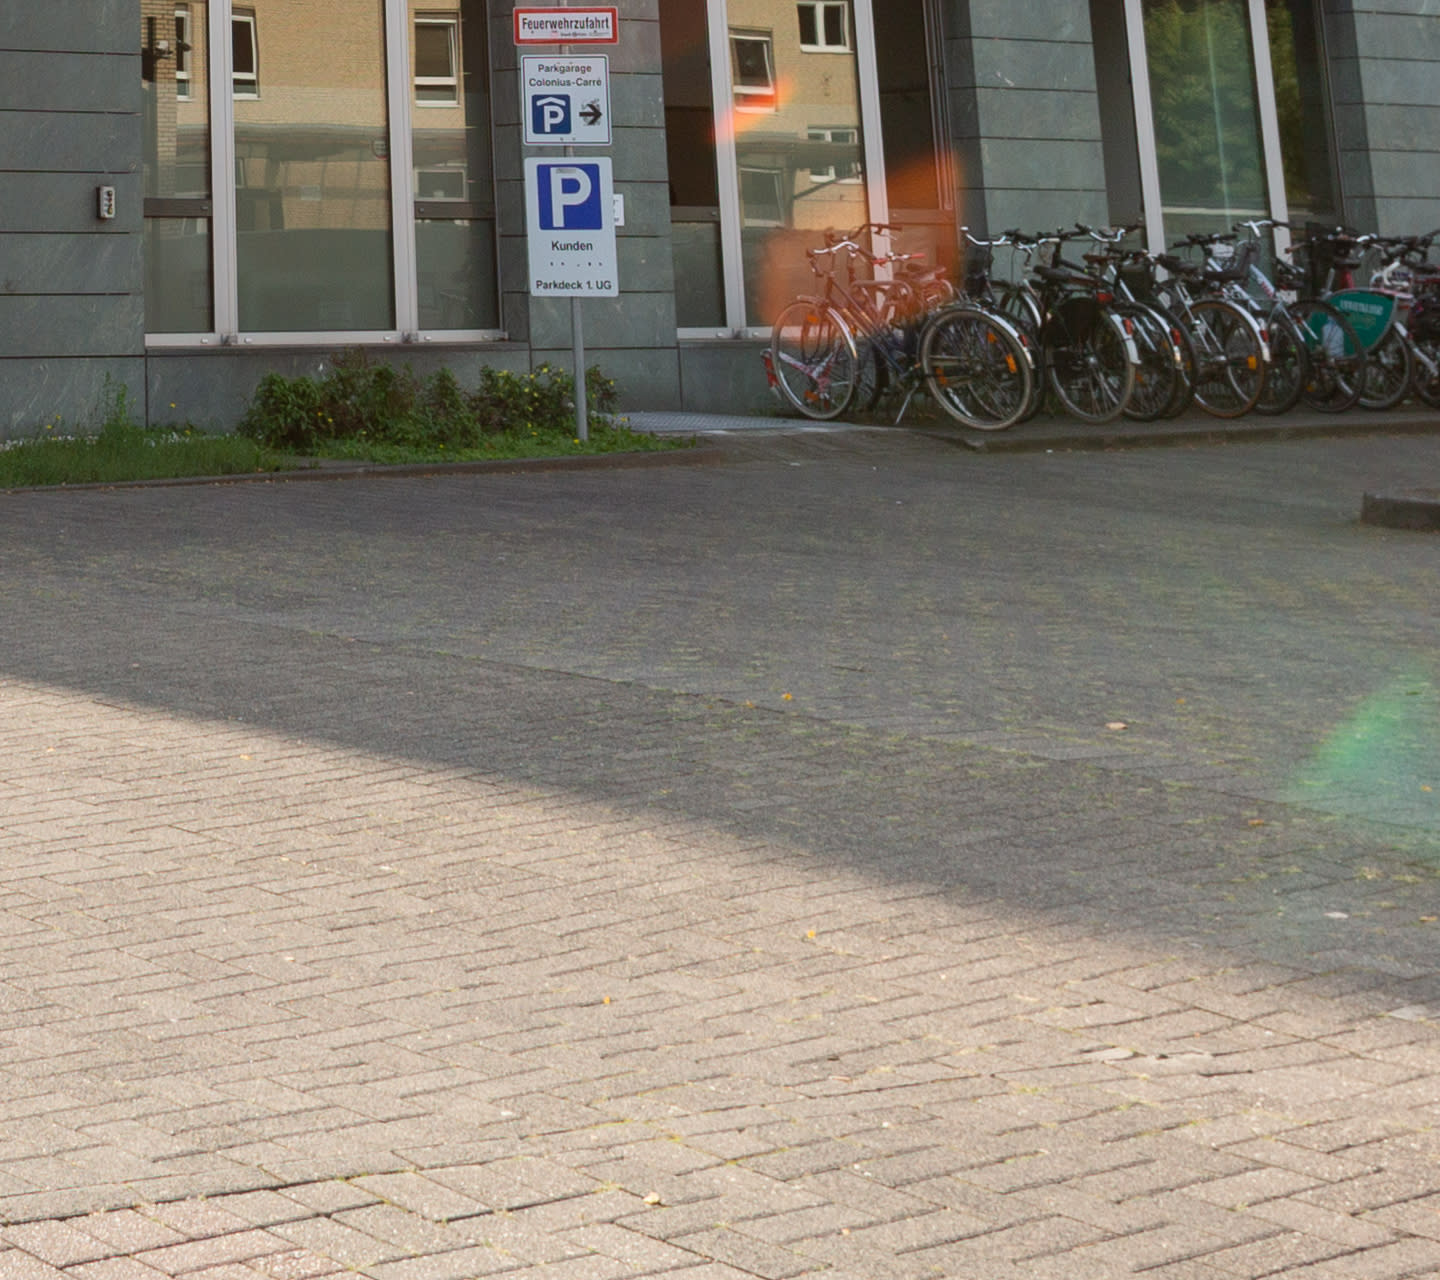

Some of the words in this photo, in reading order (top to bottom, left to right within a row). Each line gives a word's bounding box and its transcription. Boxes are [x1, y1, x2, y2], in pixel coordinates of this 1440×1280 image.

[522, 16, 609, 30] Feuerwehrzufahrt
[537, 64, 592, 74] Parkgarage
[549, 167, 592, 228] P
[551, 241, 593, 251] Kunden
[535, 280, 583, 290] Parkdeck
[596, 280, 612, 290] UG
